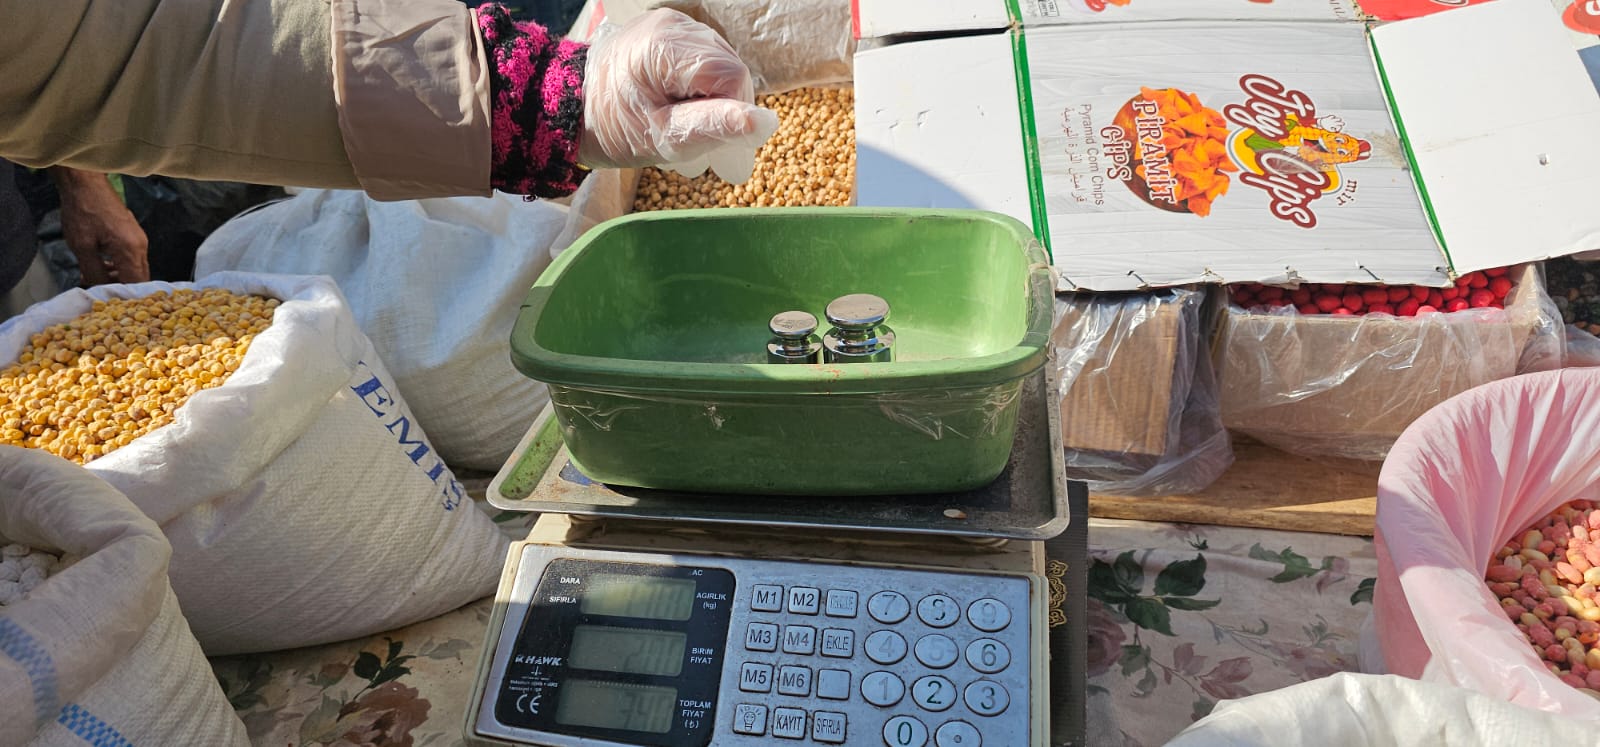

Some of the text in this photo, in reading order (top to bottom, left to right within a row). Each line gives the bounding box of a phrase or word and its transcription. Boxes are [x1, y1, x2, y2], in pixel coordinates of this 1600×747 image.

[1078, 104, 1097, 144] Pyramid
[1091, 175, 1106, 206] Chips
[1240, 150, 1331, 228] Cips
[559, 576, 581, 585] DARA
[756, 589, 778, 605] M1
[793, 591, 815, 607] M2
[882, 594, 897, 616] 7
[750, 629, 771, 645] M3
[788, 631, 809, 647] M4
[826, 634, 849, 651] EKLE
[877, 635, 892, 658] 4
[982, 643, 996, 666] 6
[745, 668, 767, 685] M5
[782, 671, 805, 687] M6
[878, 677, 889, 700] 1
[927, 681, 942, 704] 2
[679, 700, 712, 709] TOPLAM
[980, 686, 996, 710] 3
[776, 714, 803, 731] KAYIT
[897, 721, 912, 746] 0
